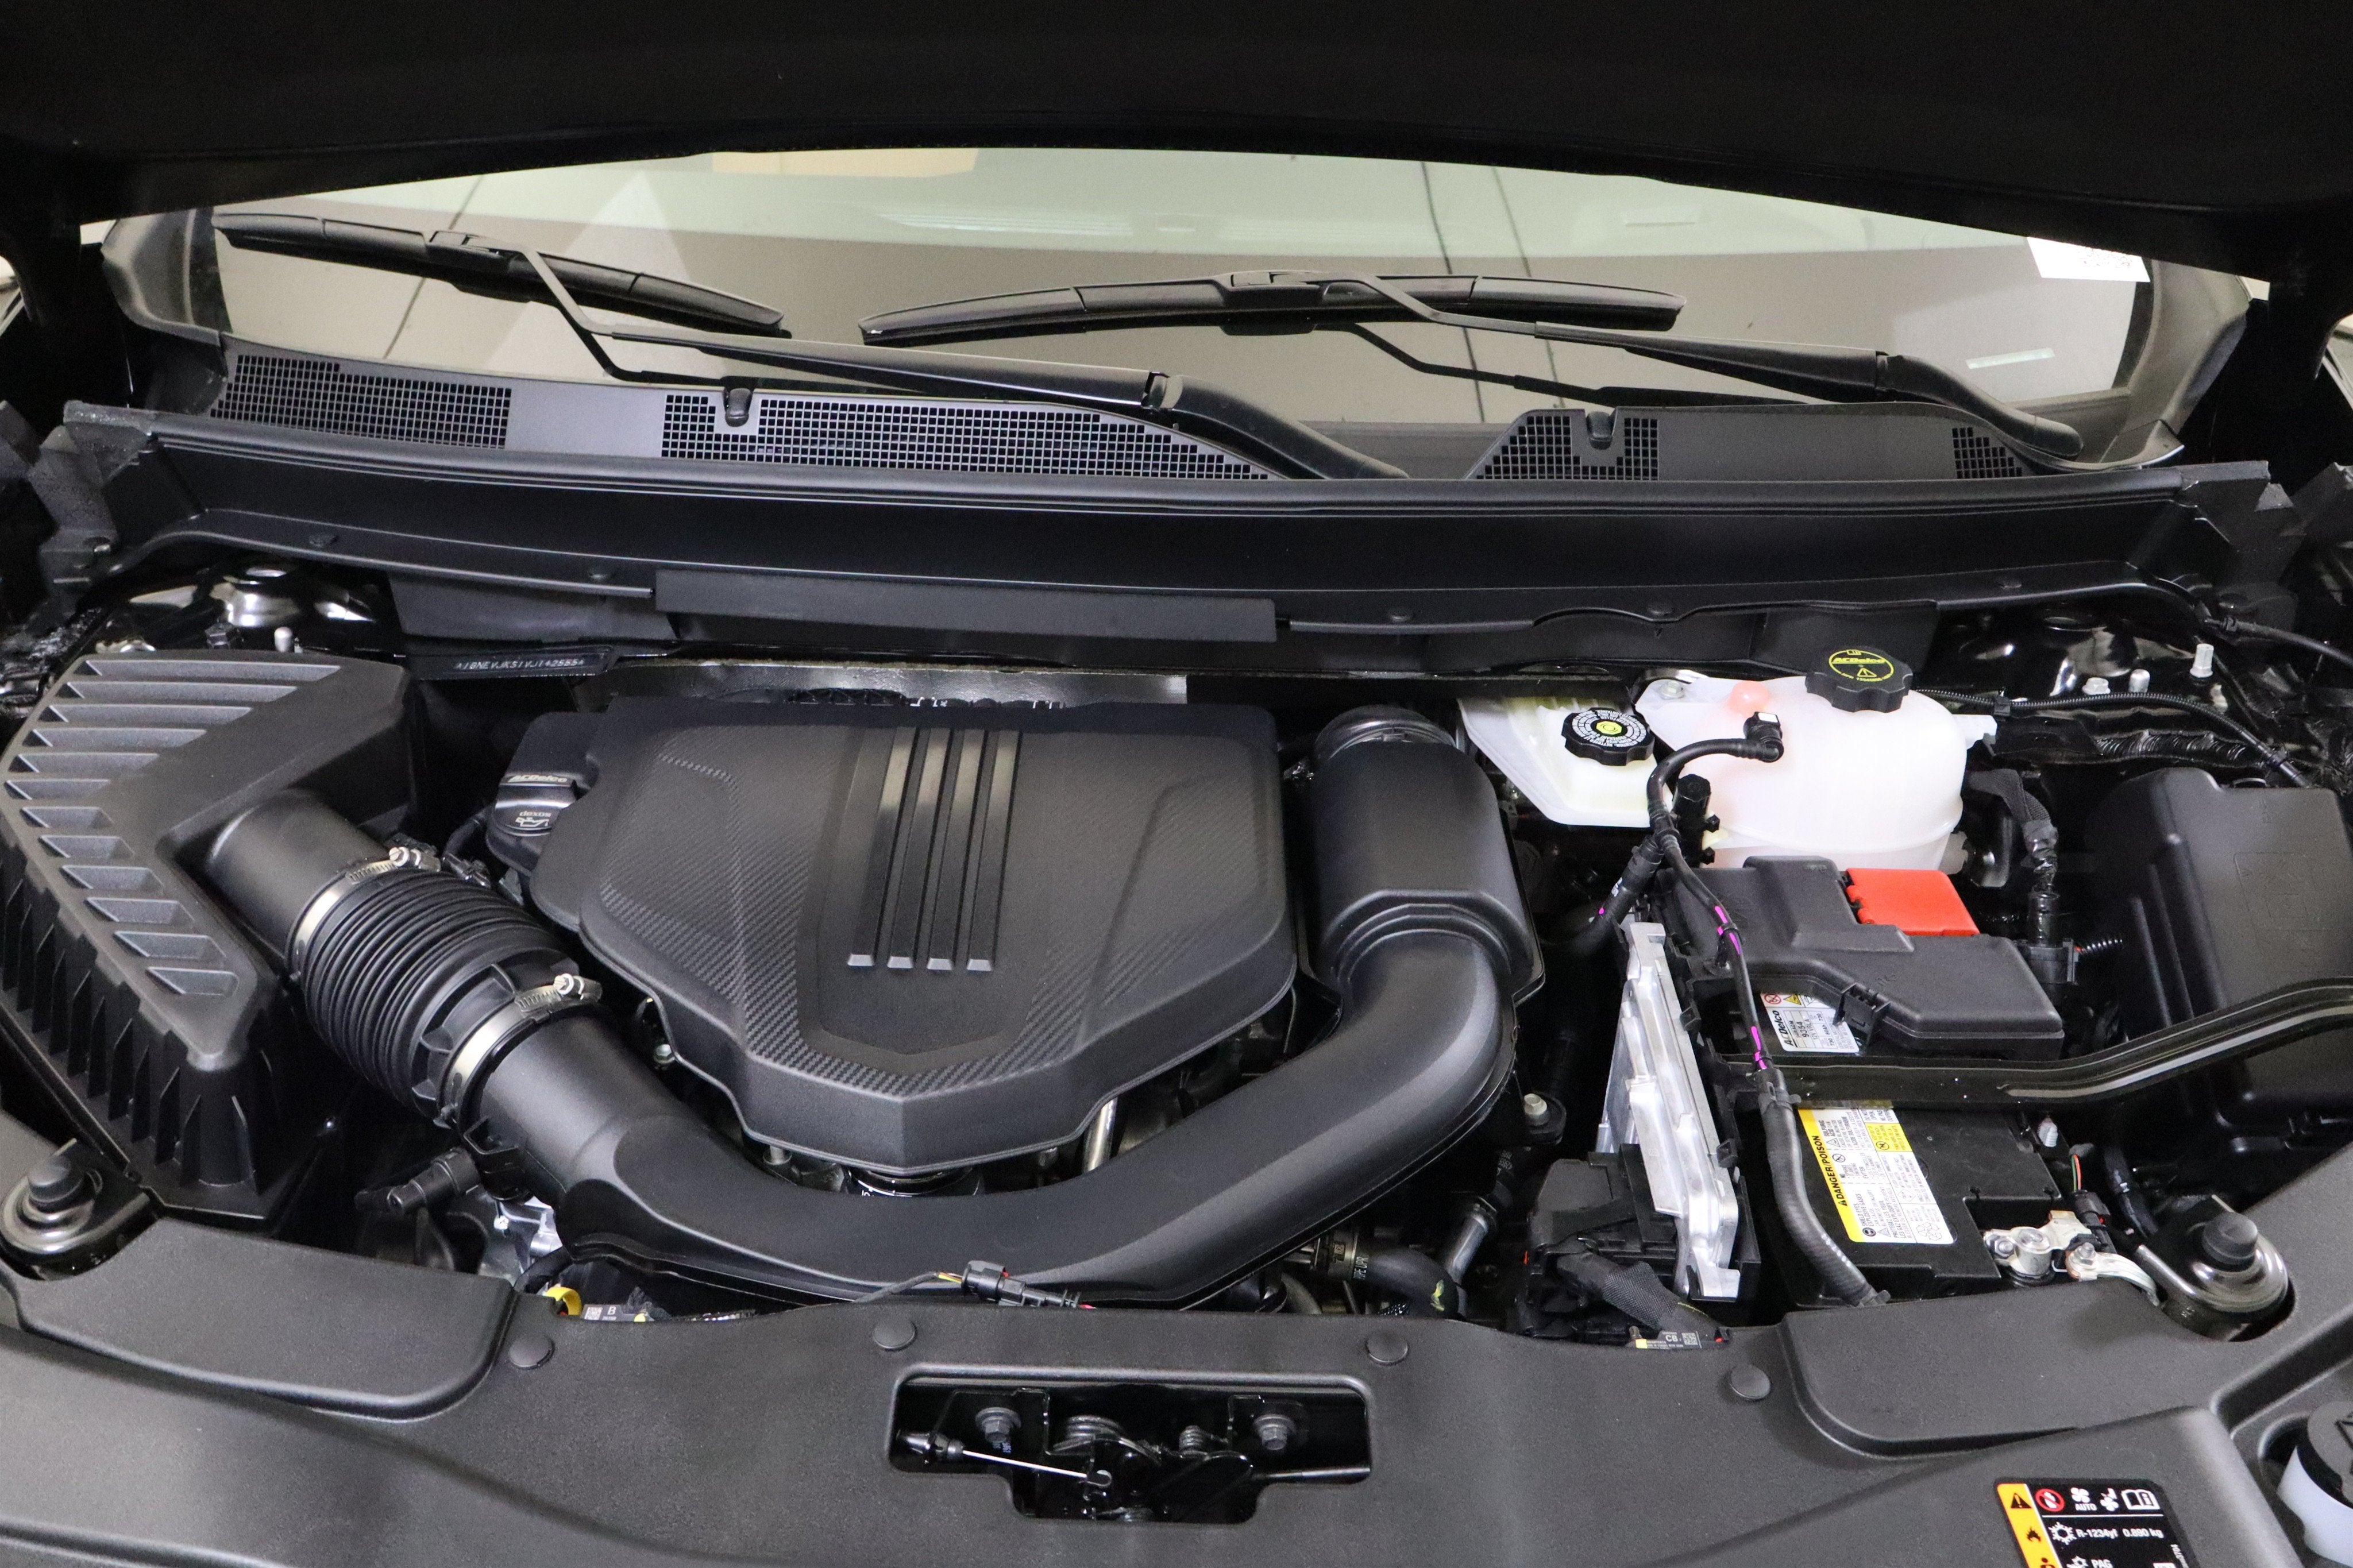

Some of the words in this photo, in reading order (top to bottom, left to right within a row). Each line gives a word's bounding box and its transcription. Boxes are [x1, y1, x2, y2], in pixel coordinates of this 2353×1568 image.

[507, 775, 568, 783] ACDelco
[1770, 1010, 1793, 1045] ACDelco
[1796, 1022, 1809, 1037] 9354
[1812, 1136, 1843, 1199] DANGER/POISON
[607, 1306, 616, 1315] B
[2075, 1503, 2097, 1511] AUTO
[2075, 1528, 2118, 1539] R-1234yf
[2122, 1528, 2150, 1538] 0.890
[2149, 1528, 2164, 1539] kg
[2091, 1559, 2113, 1568] PAG
